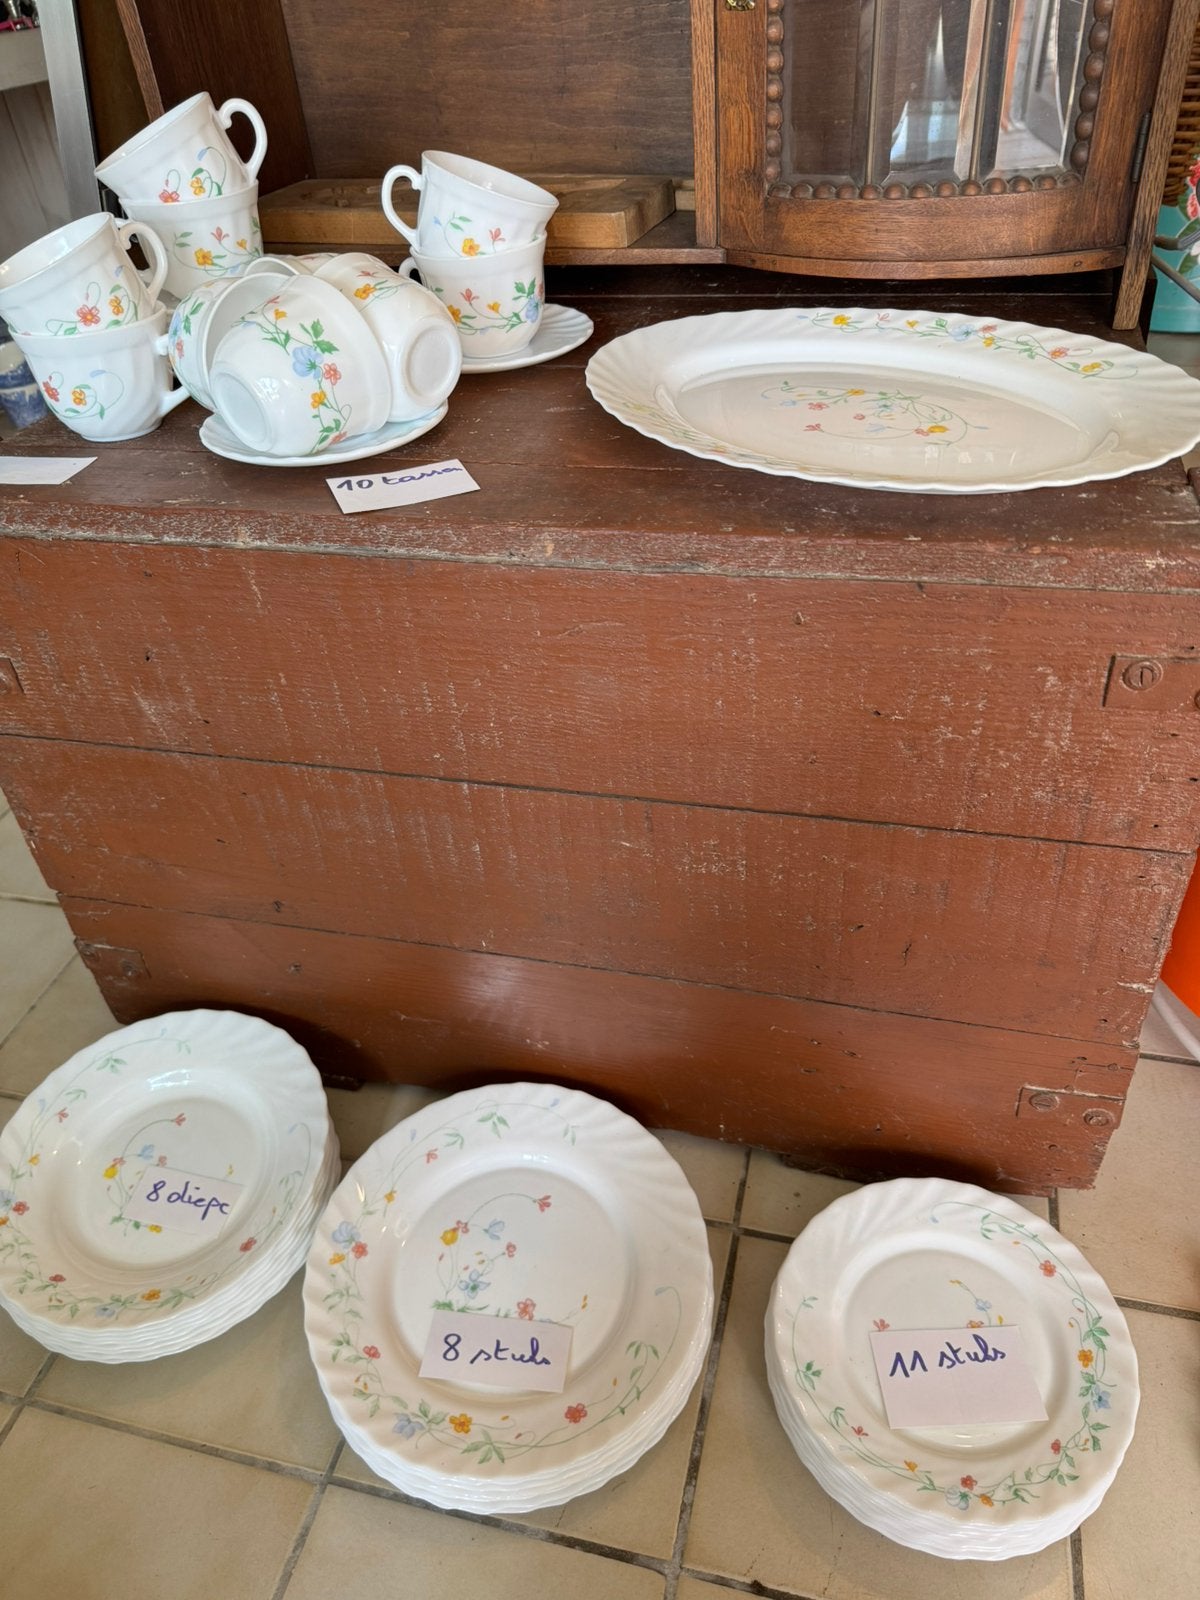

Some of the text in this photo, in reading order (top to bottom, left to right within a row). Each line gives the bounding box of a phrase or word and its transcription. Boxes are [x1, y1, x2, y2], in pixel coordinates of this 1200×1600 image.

[336, 479, 374, 491] 10
[146, 1180, 166, 1202] 8
[442, 1333, 462, 1361] 8
[889, 1350, 928, 1378] 11
